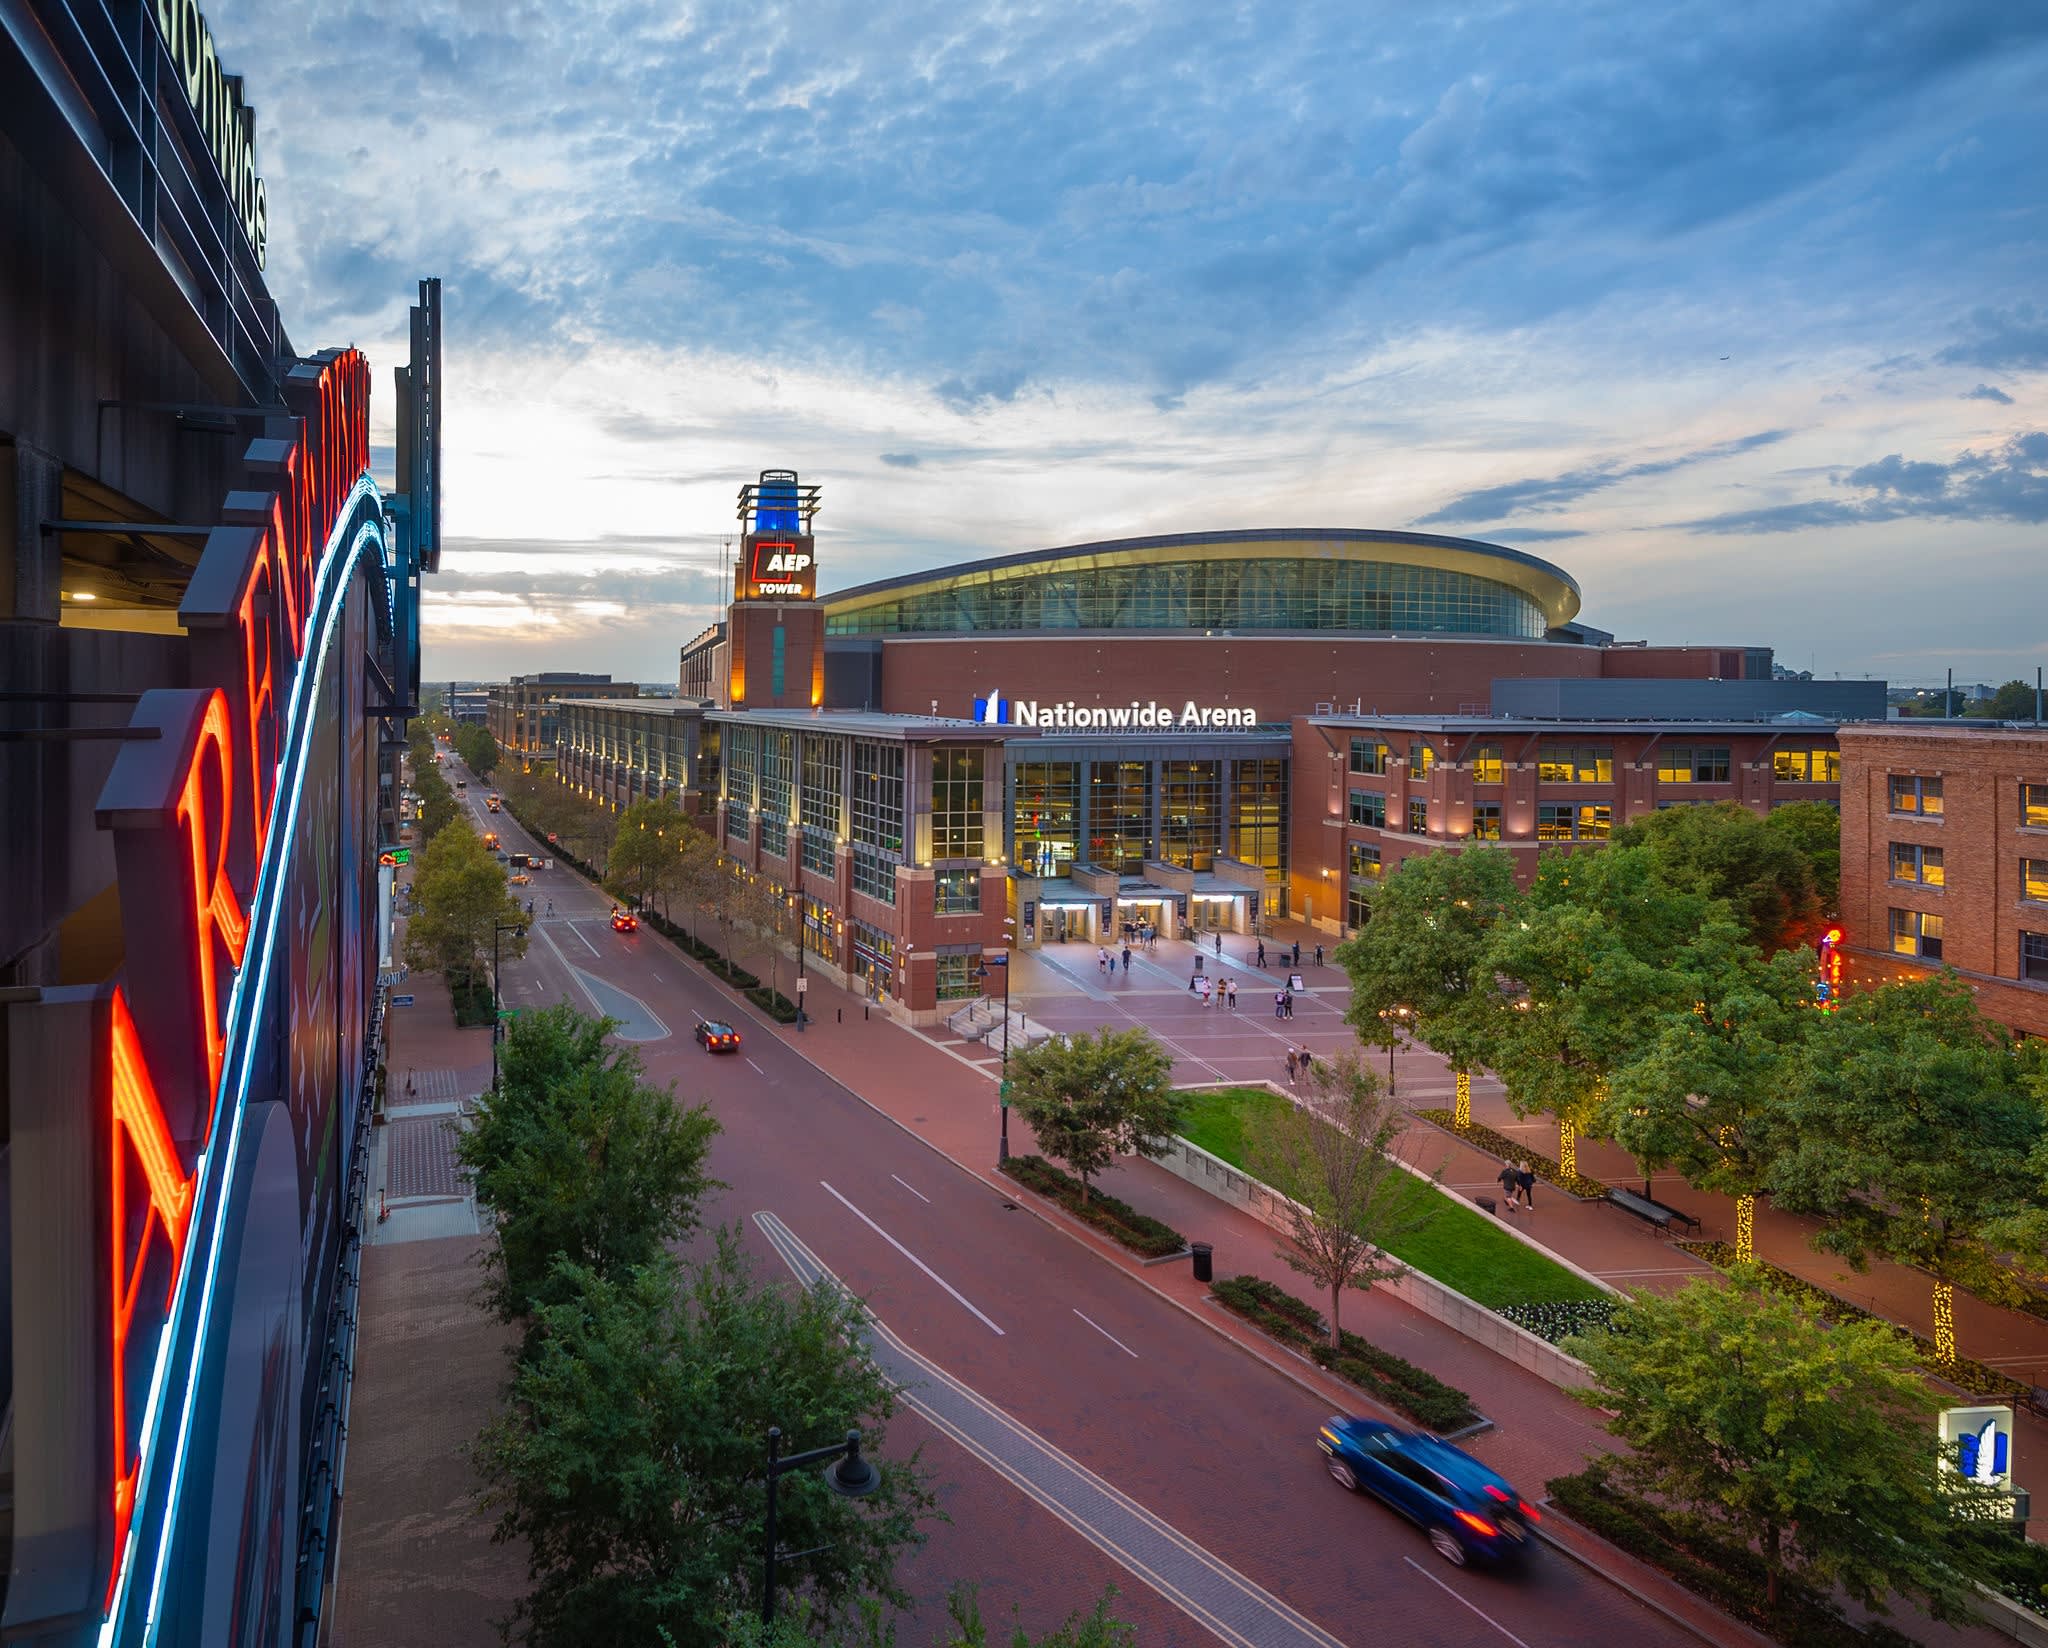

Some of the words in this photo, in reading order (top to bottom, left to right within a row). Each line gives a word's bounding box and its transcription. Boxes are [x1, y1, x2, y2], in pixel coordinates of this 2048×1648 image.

[766, 554, 811, 572] AEP
[759, 583, 803, 595] TOWER
[1014, 701, 1173, 727] Nationwide
[1180, 701, 1257, 727] Arena
